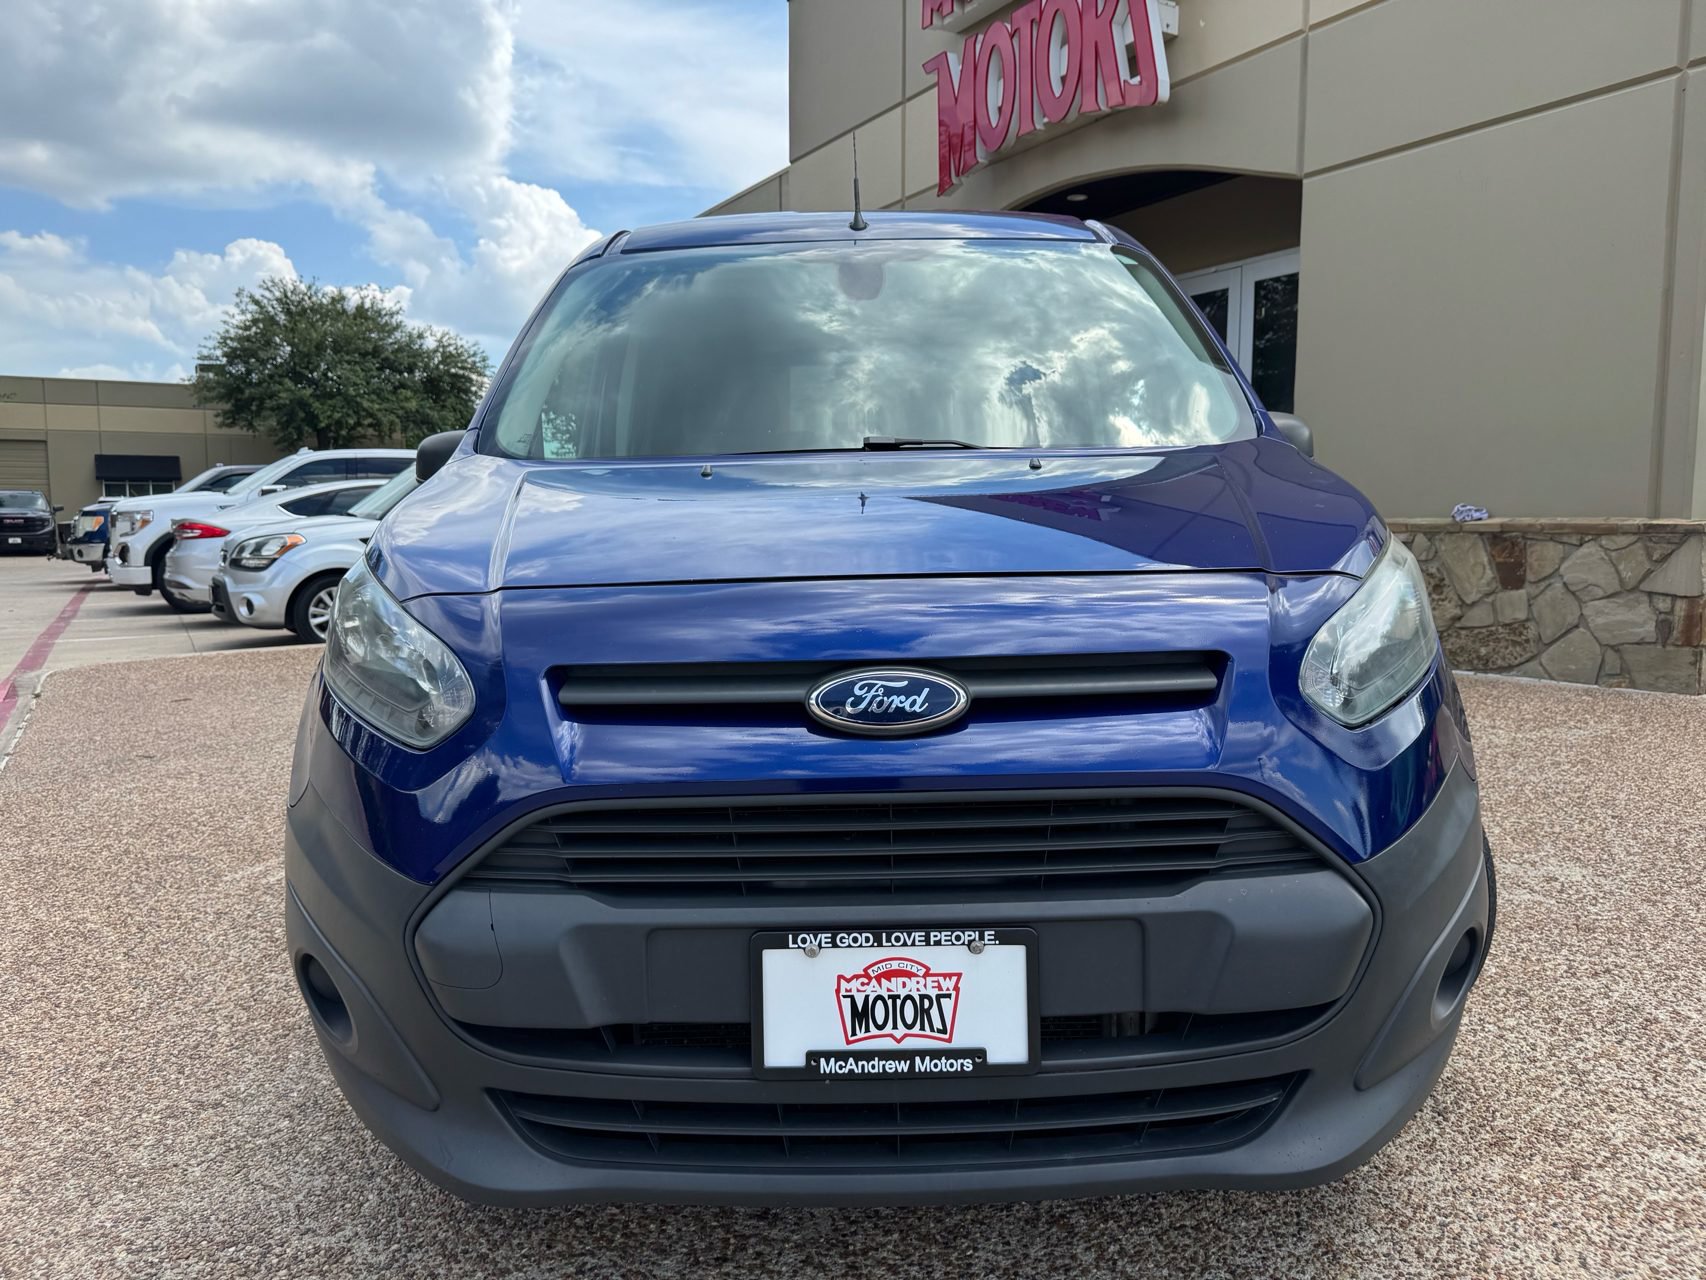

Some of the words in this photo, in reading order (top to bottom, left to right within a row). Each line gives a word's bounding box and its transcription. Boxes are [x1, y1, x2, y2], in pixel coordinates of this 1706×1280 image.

[922, 0, 1159, 197] MOTORS
[845, 680, 930, 715] Ford
[788, 933, 833, 948] LOVE
[836, 932, 878, 947] GOD.
[882, 932, 926, 947] LOVE
[930, 930, 1000, 946] PEOPLE.
[871, 962, 893, 975] MID
[897, 962, 923, 973] CITY
[841, 993, 953, 1038] MOTORS
[819, 1056, 911, 1074] McAndrew
[914, 1055, 974, 1072] Motors
